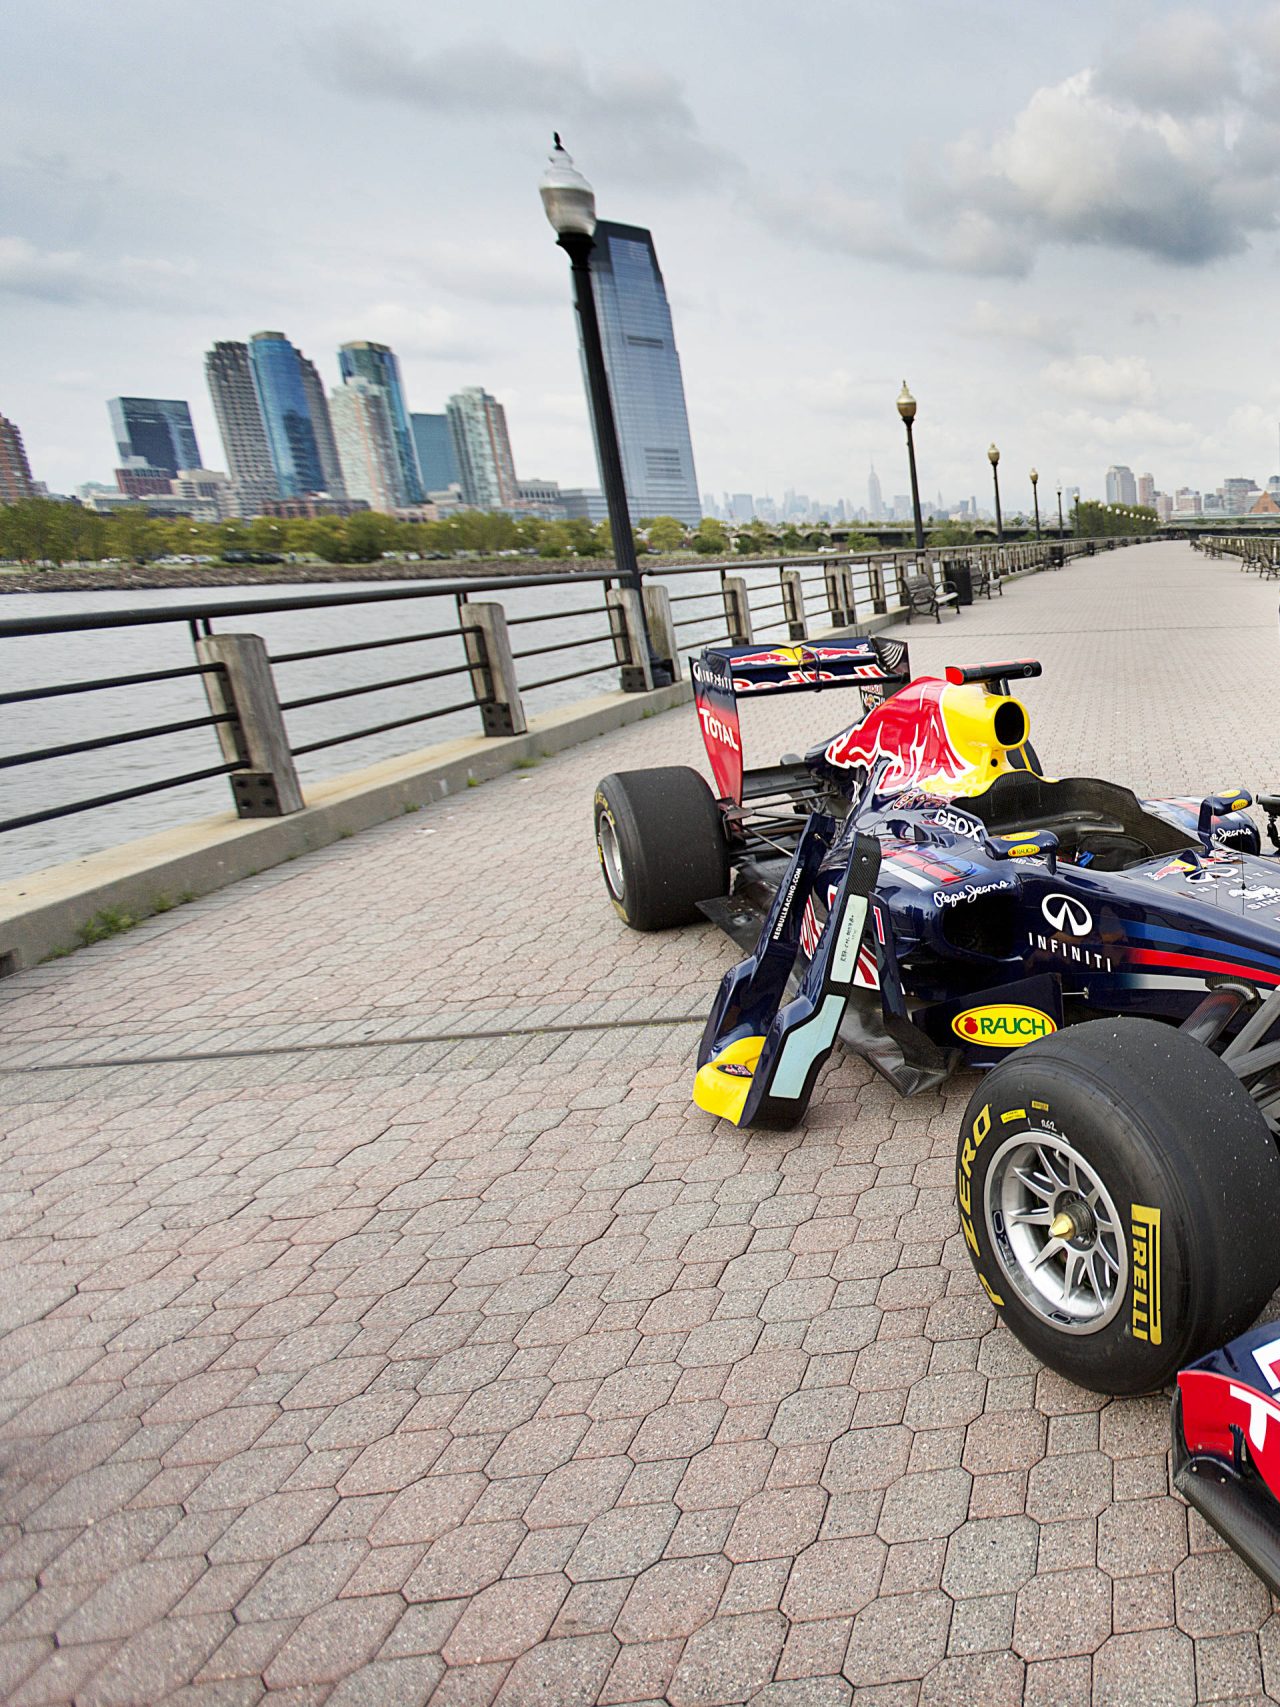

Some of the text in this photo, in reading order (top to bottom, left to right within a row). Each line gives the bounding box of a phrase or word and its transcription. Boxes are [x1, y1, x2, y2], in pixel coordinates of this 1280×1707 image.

[699, 707, 739, 752] TOTAL
[933, 809, 984, 842] GEOX
[933, 880, 1010, 908] Pepe Jeans
[1187, 870, 1274, 896] INFINITI
[1028, 932, 1112, 973] INFINITI
[981, 1017, 1046, 1035] RAUCH
[959, 1103, 992, 1257] ZERO
[1131, 1203, 1162, 1345] PIRELLI
